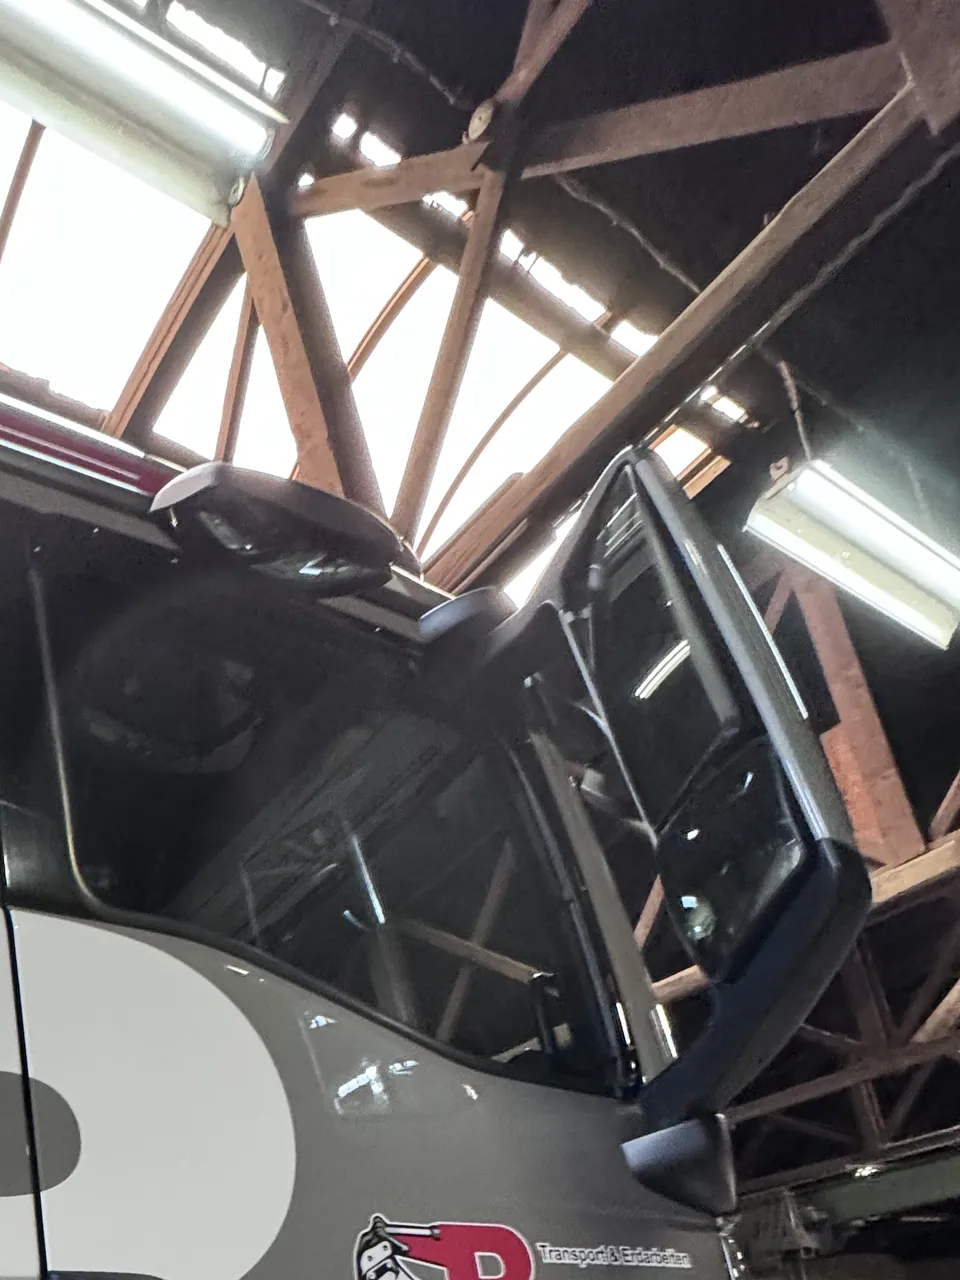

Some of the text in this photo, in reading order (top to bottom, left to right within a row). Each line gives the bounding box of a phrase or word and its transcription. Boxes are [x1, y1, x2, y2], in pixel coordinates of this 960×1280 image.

[535, 1242, 693, 1268] Transport & Erdarbeiten
